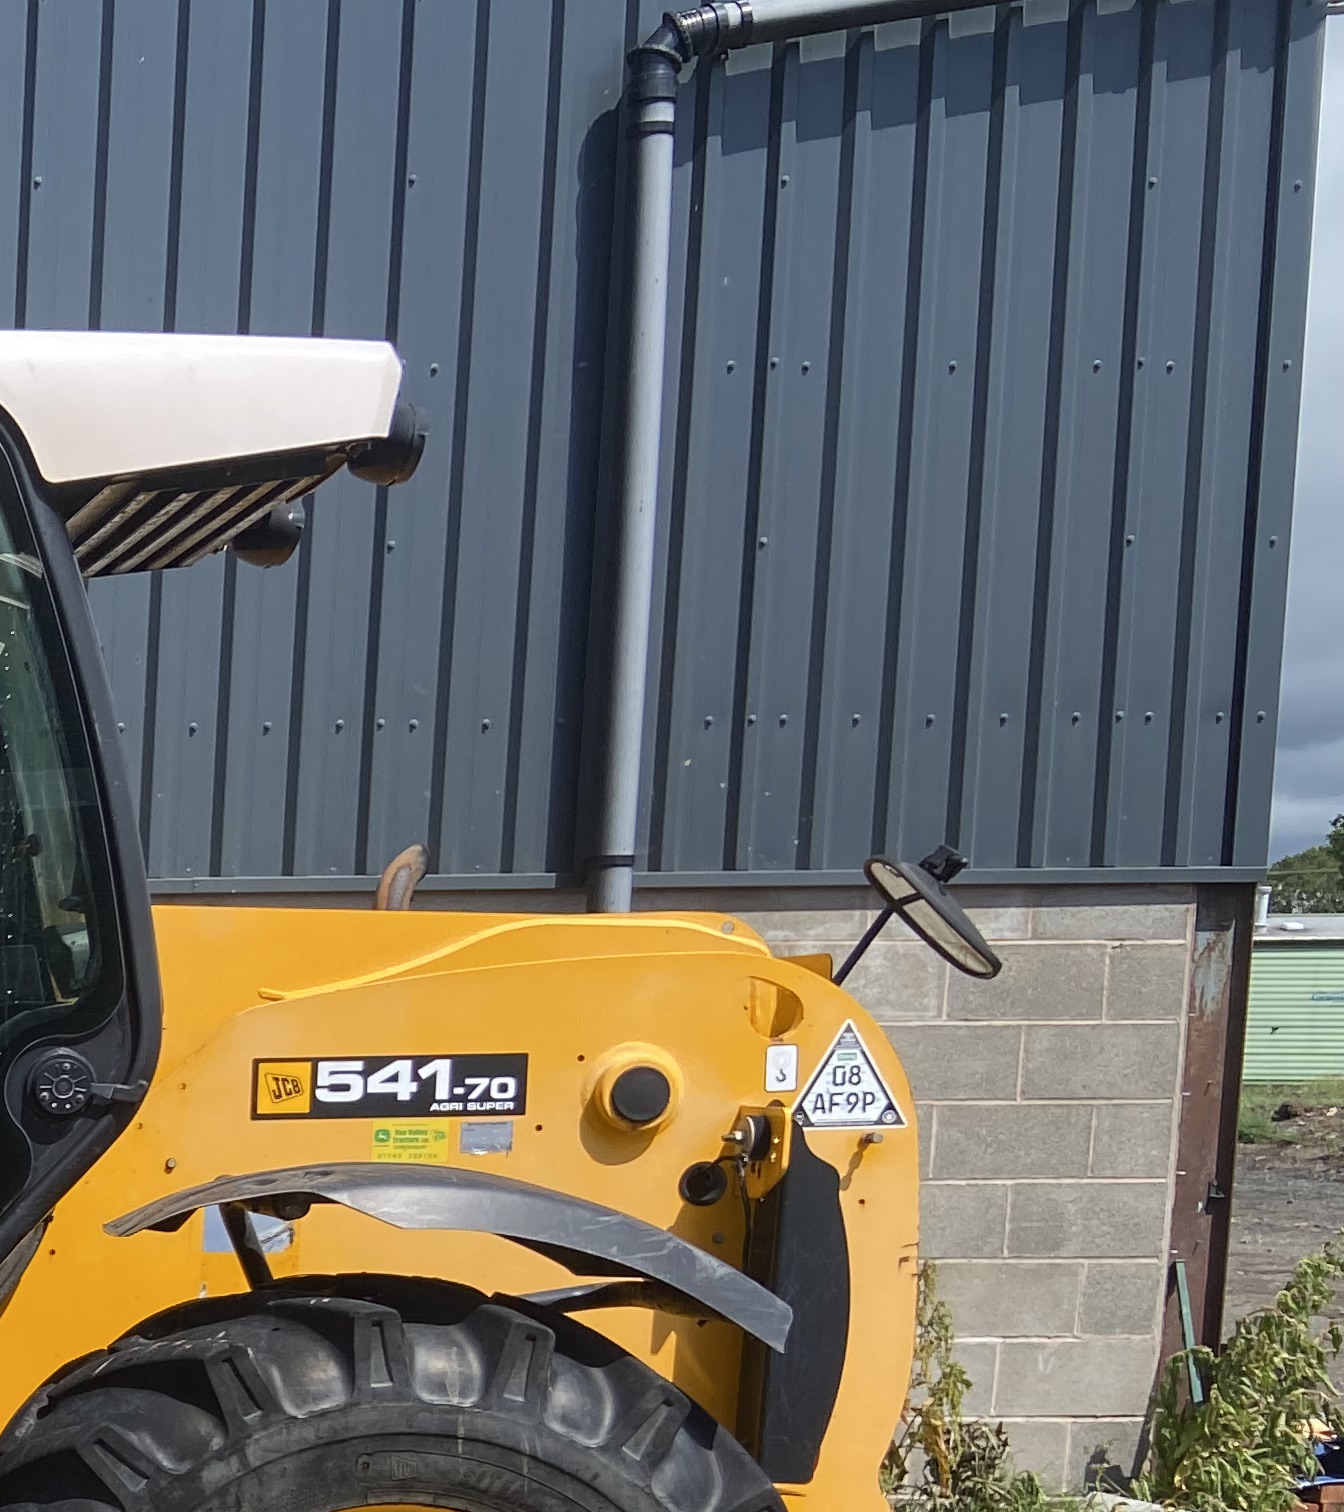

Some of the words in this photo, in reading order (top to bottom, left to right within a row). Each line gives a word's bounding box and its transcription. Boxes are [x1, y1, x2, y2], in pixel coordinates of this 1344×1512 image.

[271, 1076, 301, 1100] JCB
[429, 1102, 464, 1111] AGRI
[466, 1101, 515, 1111] SUPER
[812, 1091, 876, 1114] AF9P
